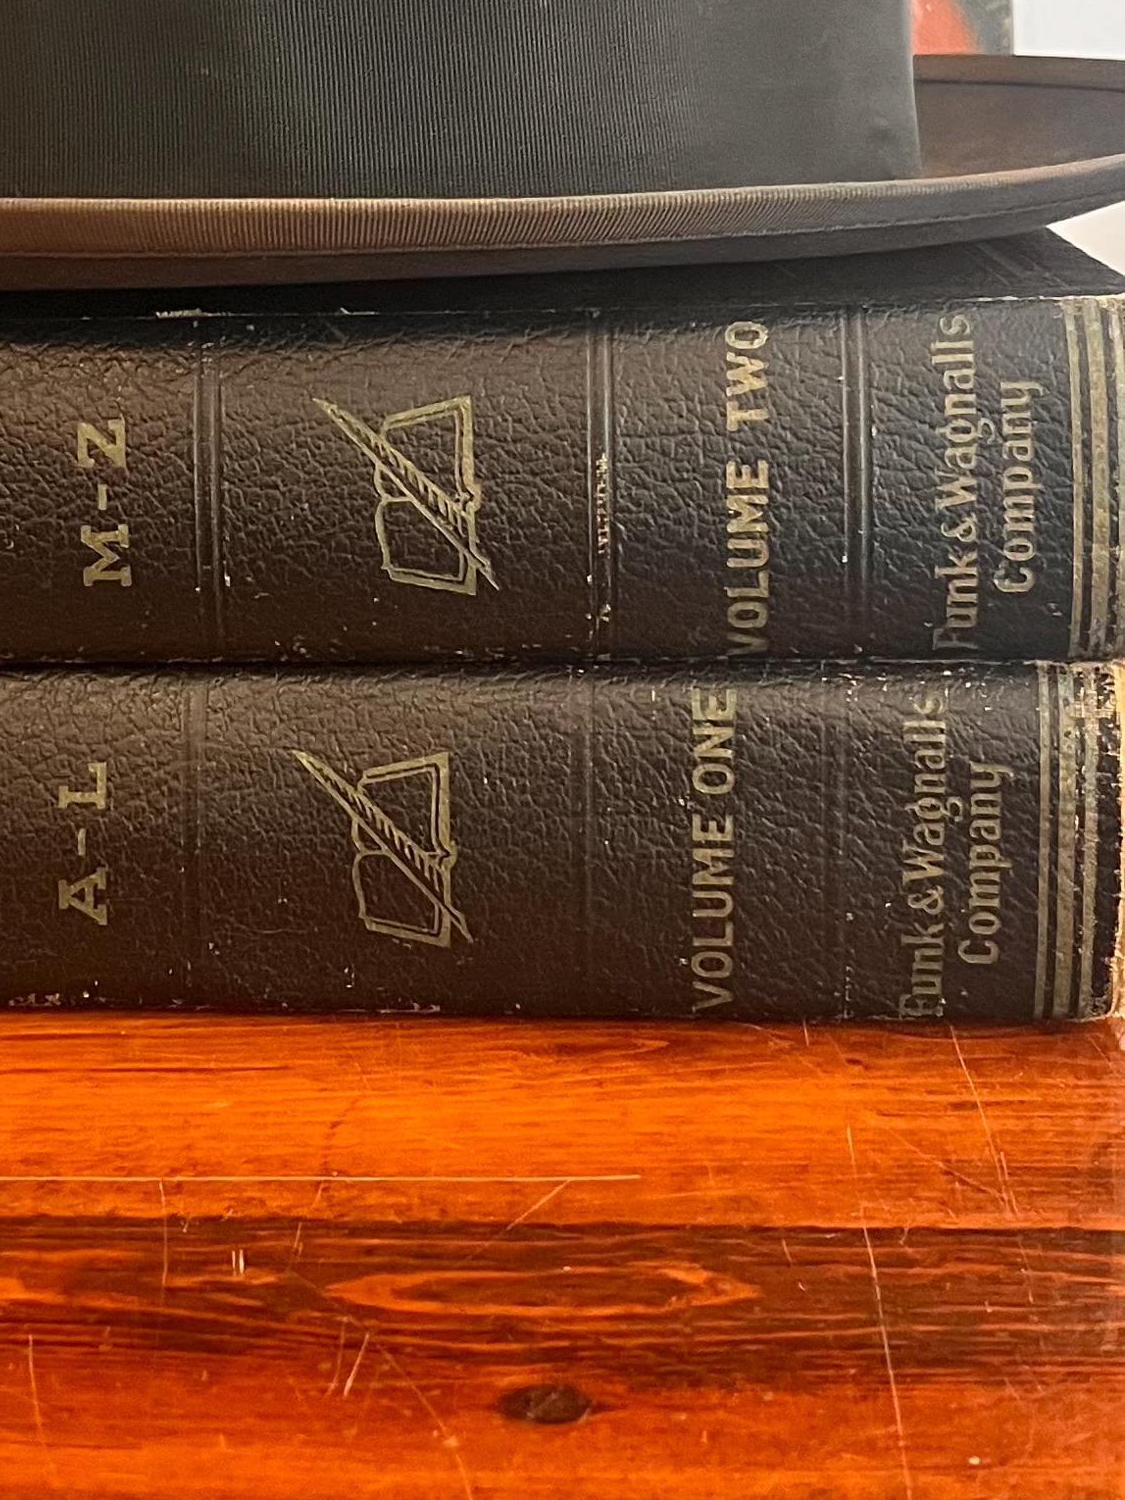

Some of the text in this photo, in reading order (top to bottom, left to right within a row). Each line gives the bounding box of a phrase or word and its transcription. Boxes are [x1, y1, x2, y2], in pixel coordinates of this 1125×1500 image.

[725, 321, 770, 657] VOLUME TWO
[932, 313, 998, 651] Funk & Wagnalls
[994, 379, 1044, 594] Company
[690, 687, 736, 1013] VOLUME ONE
[898, 692, 962, 1020] Funk & Wagnalls
[957, 760, 1012, 965] Company
